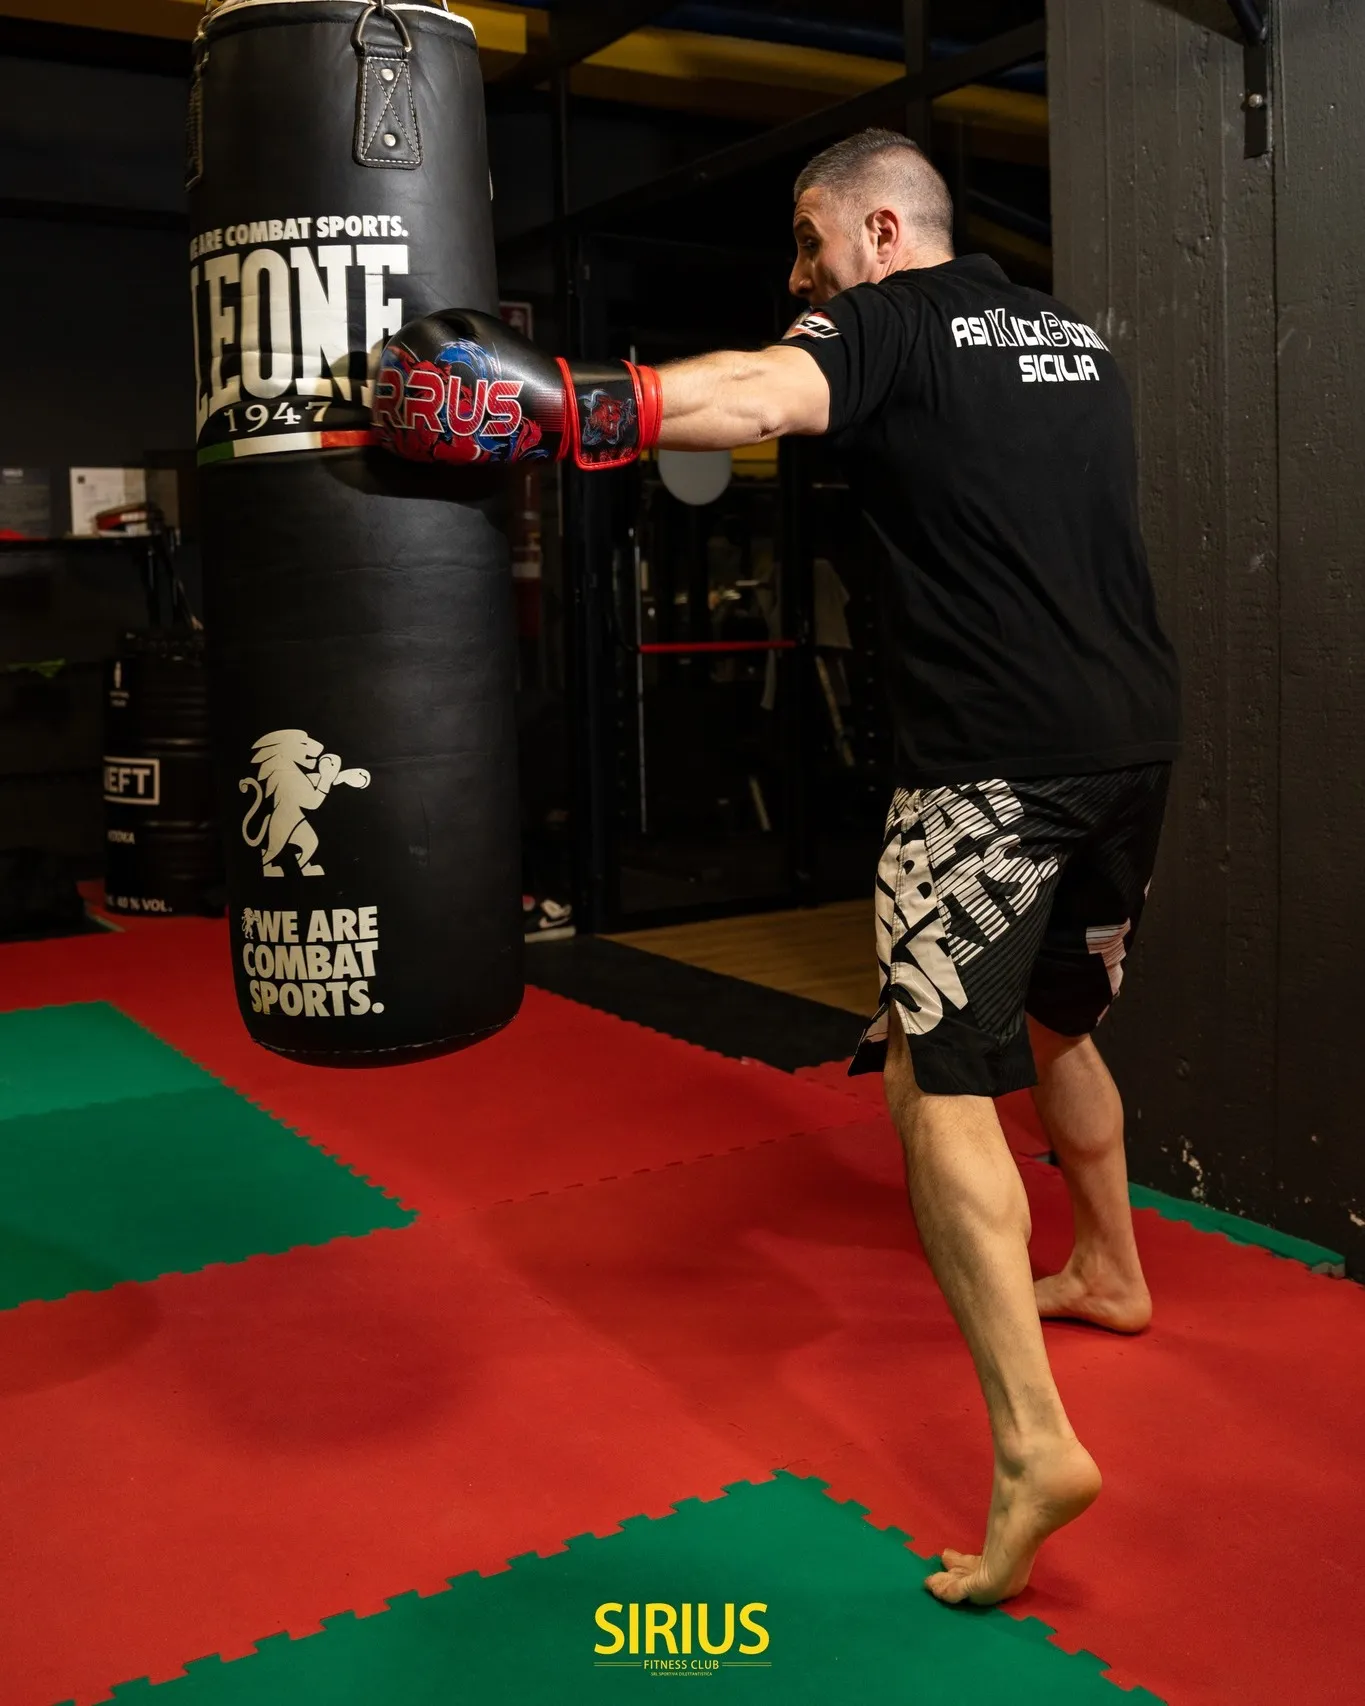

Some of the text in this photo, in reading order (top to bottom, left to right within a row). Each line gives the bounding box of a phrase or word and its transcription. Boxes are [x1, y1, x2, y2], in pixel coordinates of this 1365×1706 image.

[199, 228, 223, 256] ARE
[225, 217, 314, 246] COMBAT
[316, 214, 409, 238] SPORTS.
[1018, 354, 1100, 382] SICILIA
[224, 402, 332, 433] 1947
[254, 906, 379, 943] WE ARE
[243, 940, 379, 980] COMBAT
[250, 980, 385, 1017] SPORTS.
